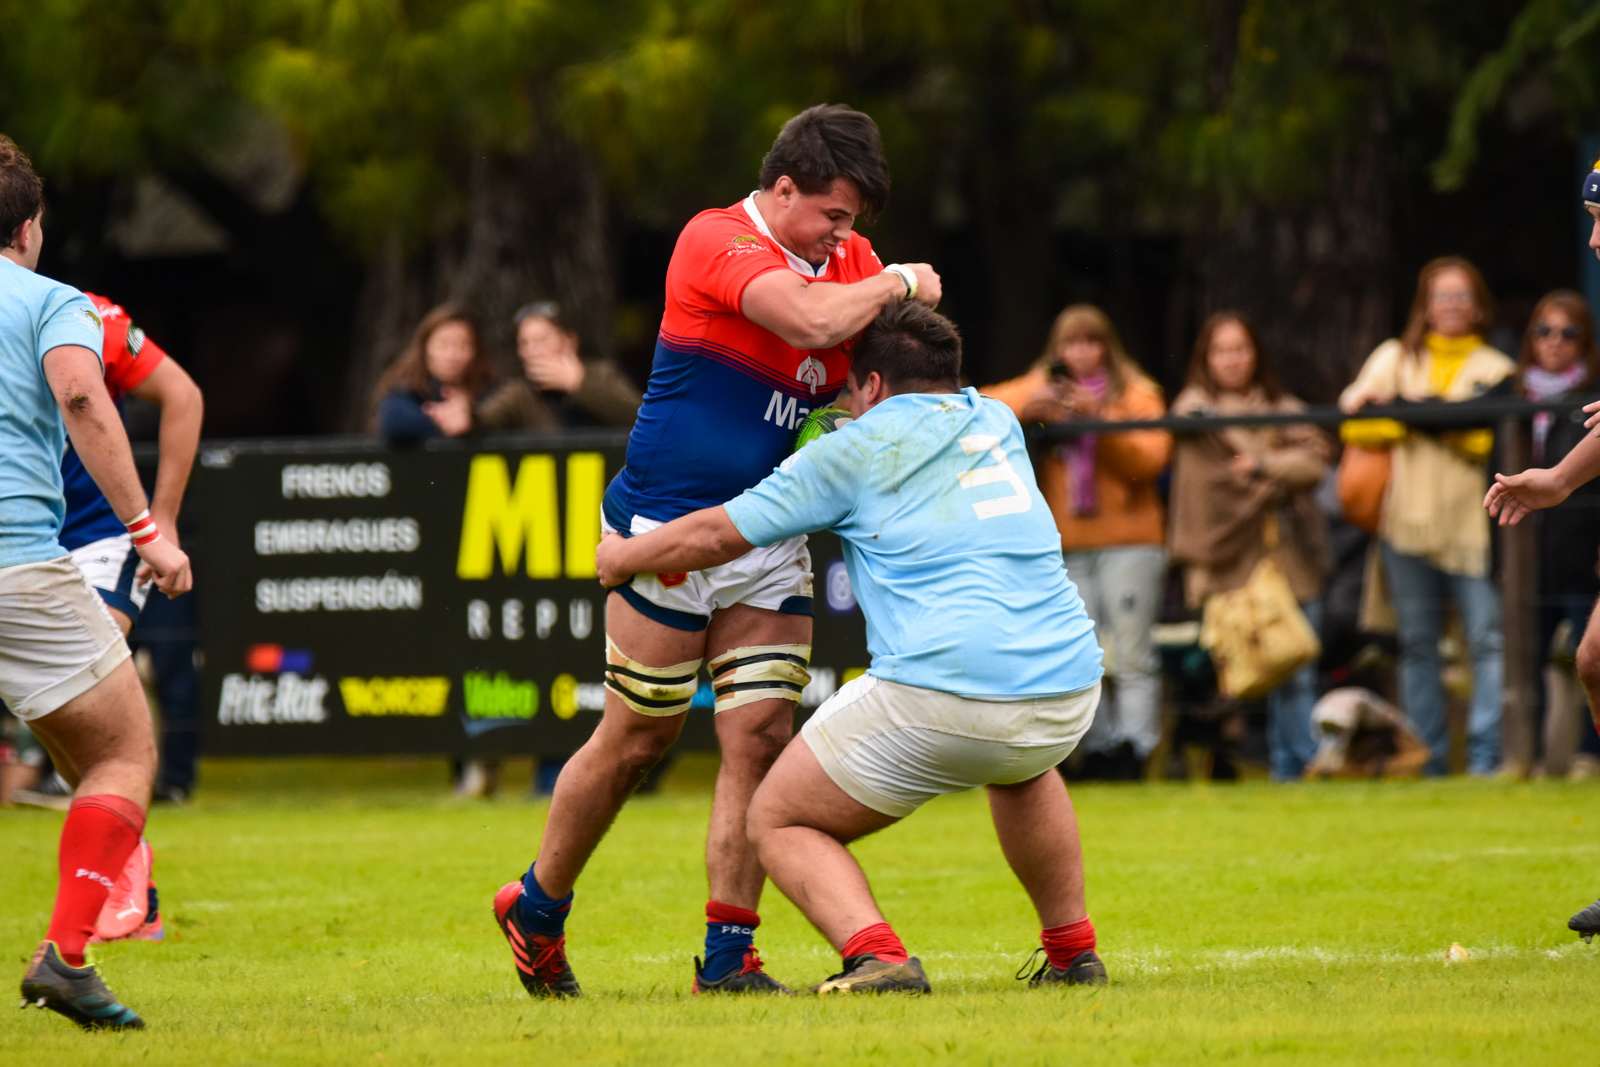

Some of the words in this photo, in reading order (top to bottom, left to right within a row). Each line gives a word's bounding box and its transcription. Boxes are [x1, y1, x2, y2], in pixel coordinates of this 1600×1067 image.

[763, 389, 835, 431] Ma
[281, 461, 391, 499] FRENOS
[956, 434, 1033, 521] 3
[254, 516, 420, 555] EMBRAGUES
[254, 569, 423, 613] SUSPENSIÓN
[467, 598, 607, 640] REPU
